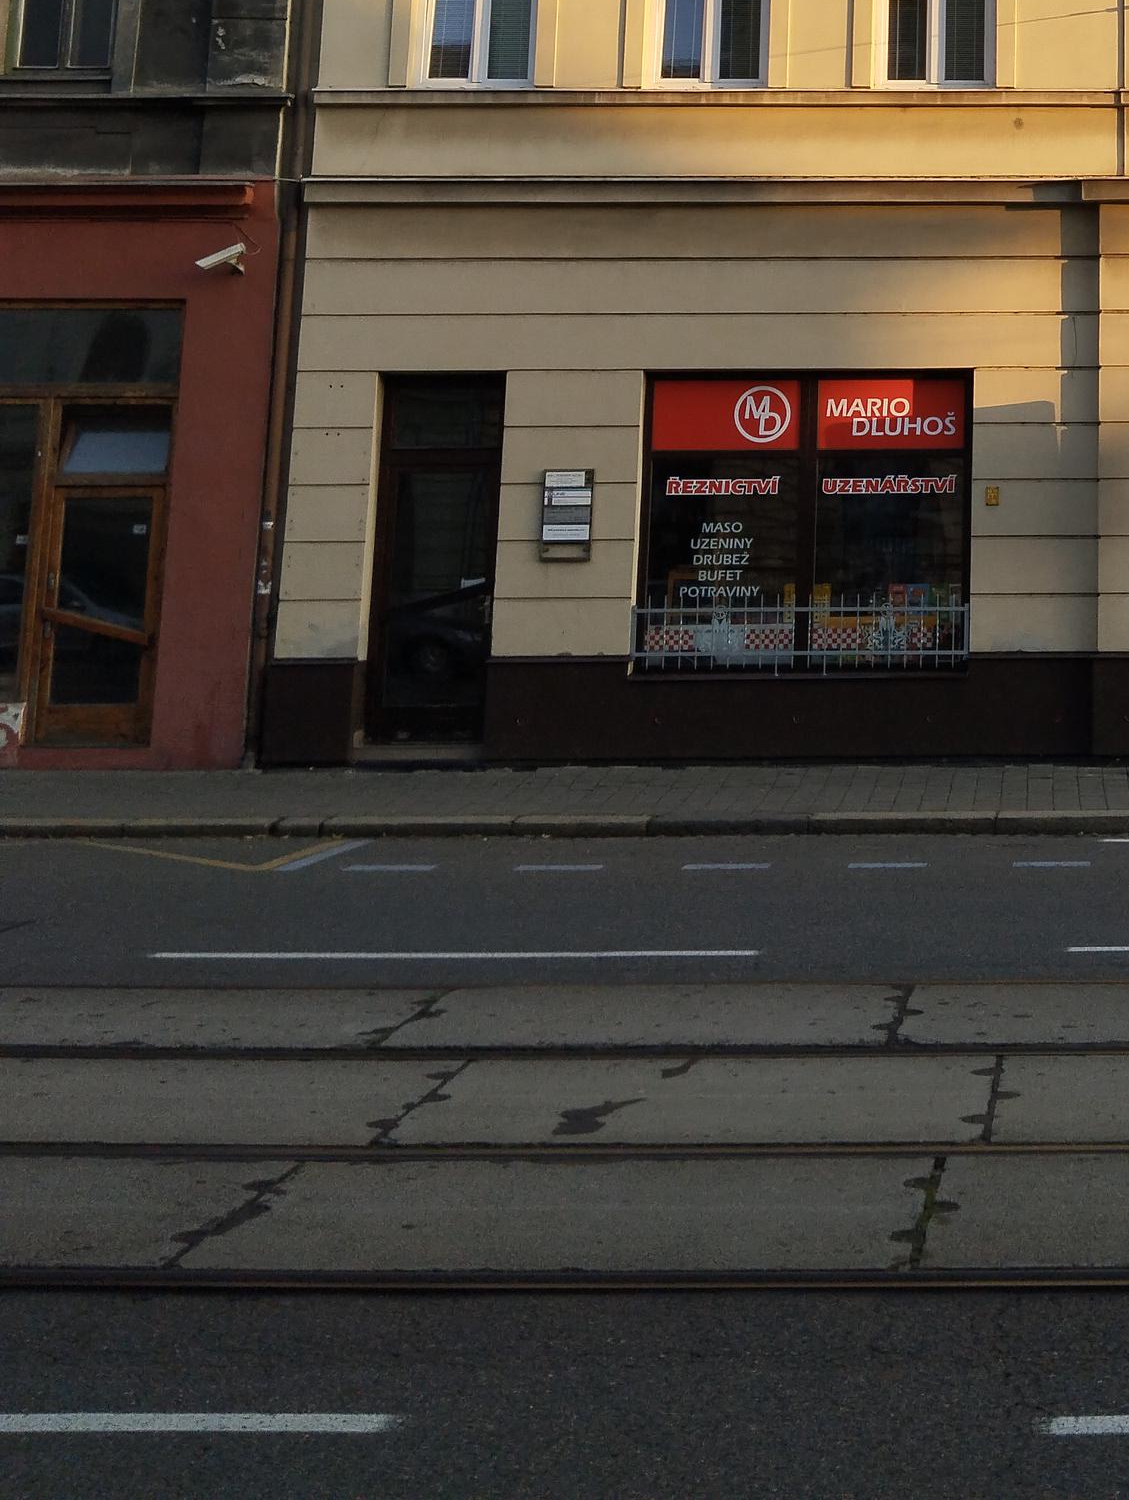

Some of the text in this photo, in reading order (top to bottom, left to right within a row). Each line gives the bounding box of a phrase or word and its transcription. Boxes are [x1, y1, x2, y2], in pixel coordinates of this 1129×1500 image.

[826, 397, 910, 417] MARIO
[852, 411, 956, 436] DLUHOŠ
[666, 476, 781, 495] ŘEZNICTVÍ
[822, 474, 957, 494] UZENÁŘSTVÍ
[701, 522, 743, 533] MASO
[690, 538, 753, 549] UZENINY
[698, 570, 743, 581] BUFET
[679, 586, 760, 597] POTRAVINY
